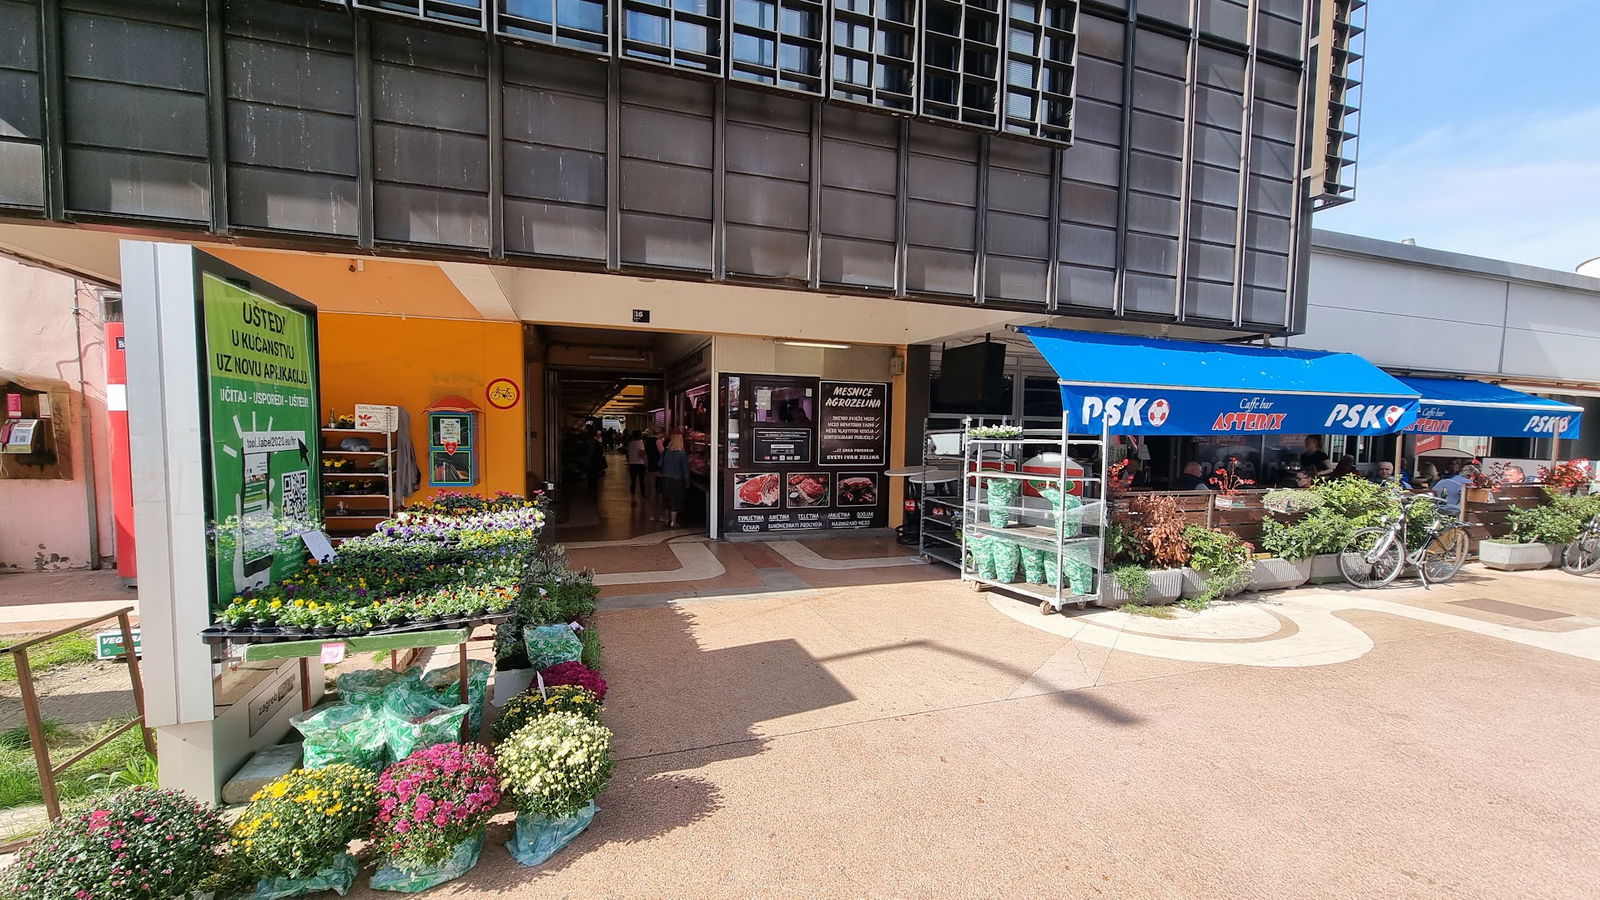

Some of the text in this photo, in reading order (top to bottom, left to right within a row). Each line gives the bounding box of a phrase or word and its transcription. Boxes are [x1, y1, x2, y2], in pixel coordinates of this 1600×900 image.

[231, 329, 295, 360] U KUĆANSTVU
[216, 352, 308, 385] UZ NOVU APLIKACIJU
[219, 386, 247, 403] UČITAJ
[253, 392, 284, 406] USPOREDI
[833, 386, 874, 397] MESNICE
[824, 397, 881, 408] AGROZELINA
[1082, 396, 1150, 427] PSK
[1239, 396, 1274, 413] Caffe bar
[1211, 412, 1288, 431] ASTERIX
[1324, 403, 1385, 429] PSK
[1523, 415, 1561, 433] PSK
